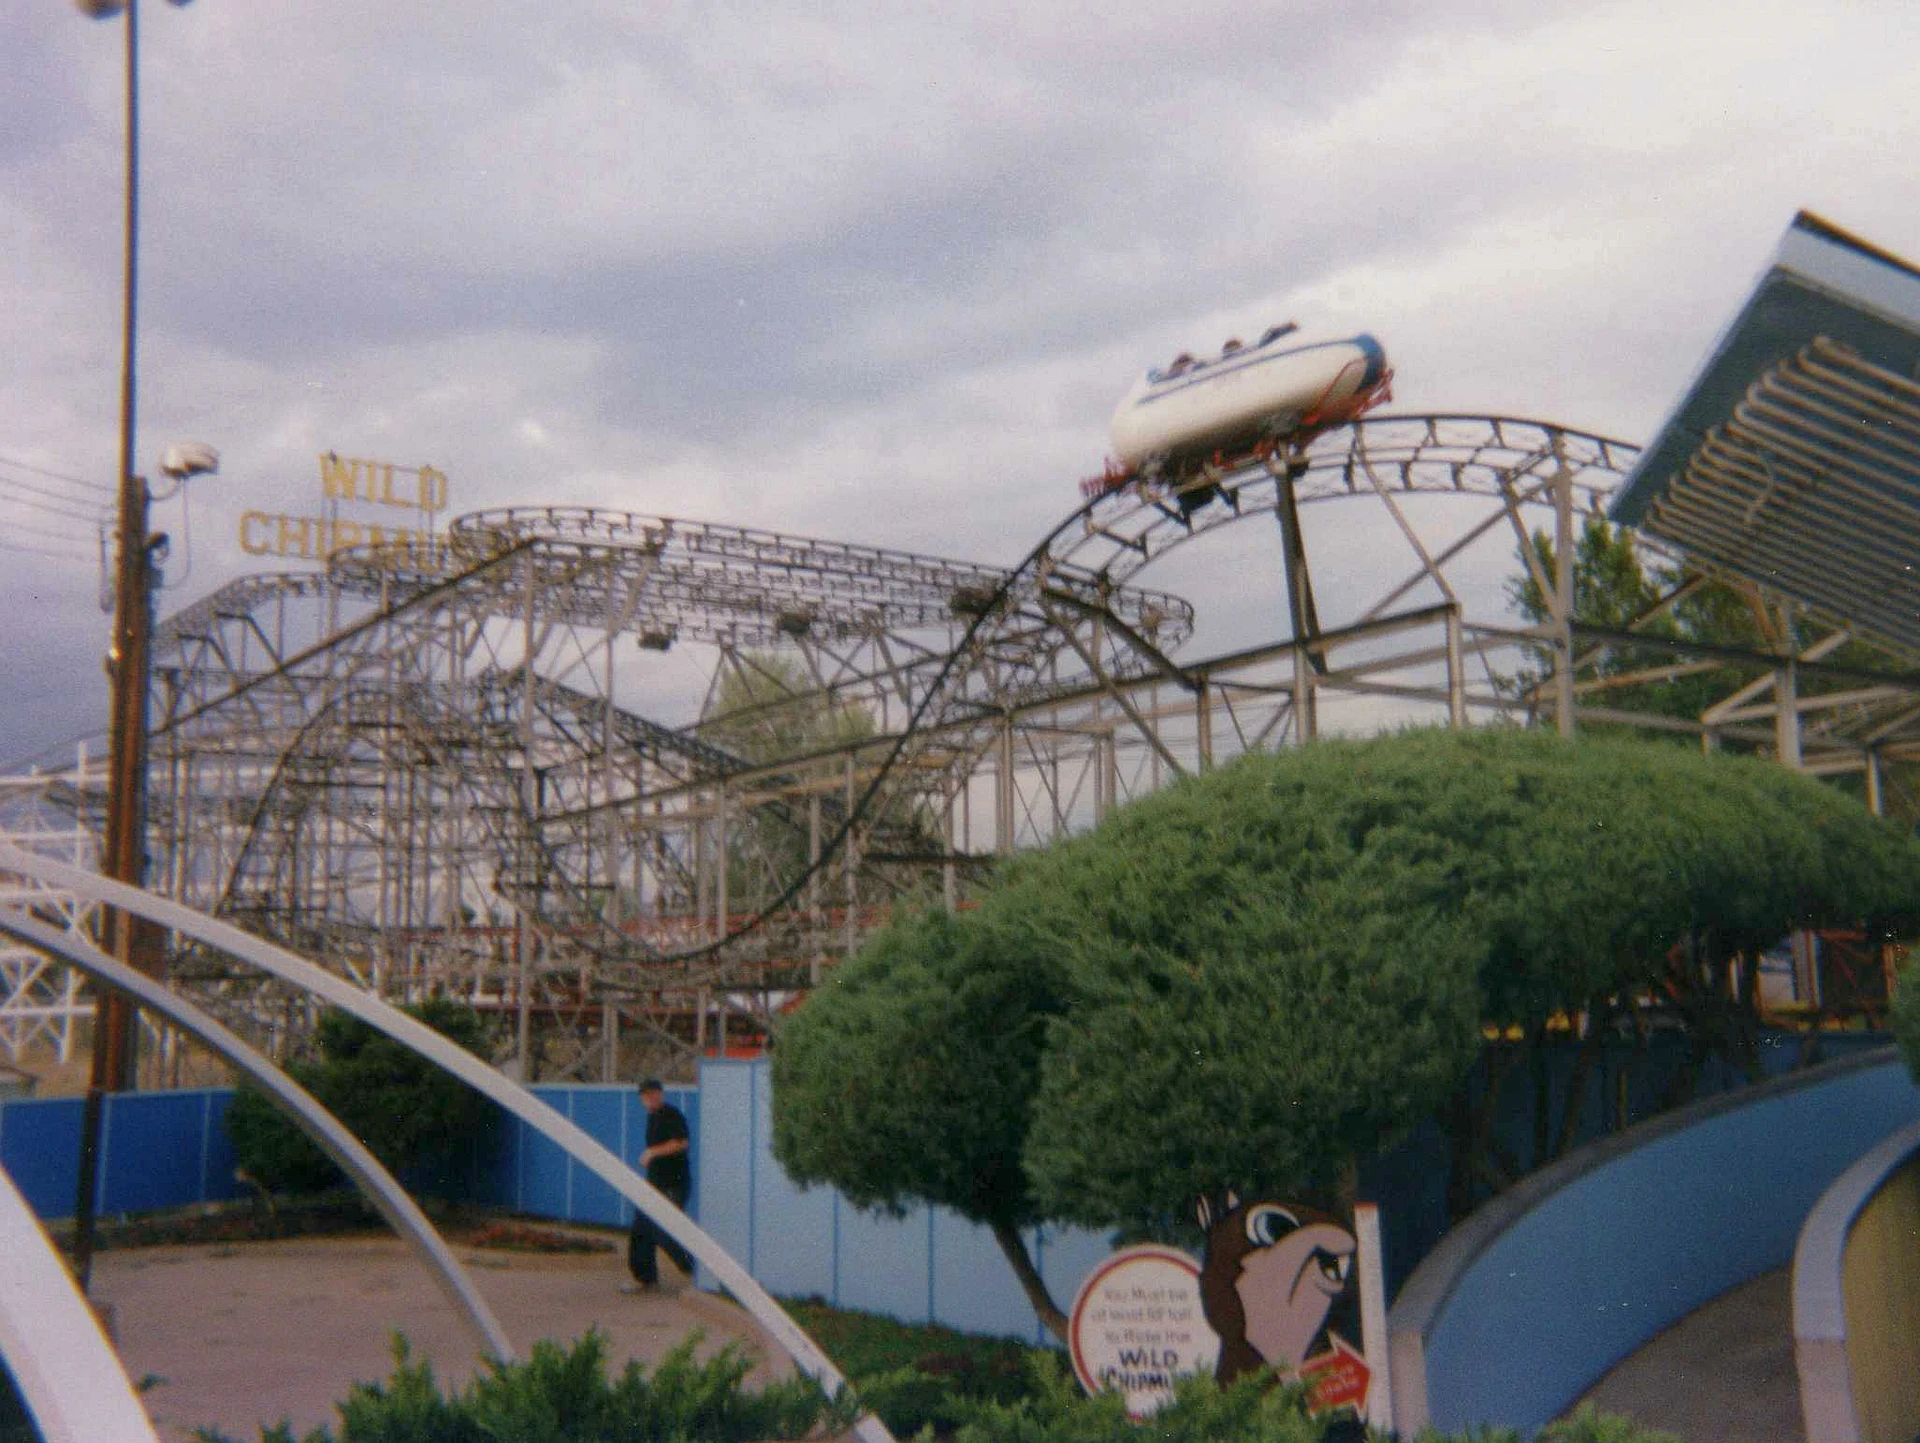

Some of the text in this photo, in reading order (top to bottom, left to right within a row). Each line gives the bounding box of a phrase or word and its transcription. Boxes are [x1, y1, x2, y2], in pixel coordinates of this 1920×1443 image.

[318, 453, 447, 511] WILD
[239, 510, 451, 575] CHIPMU
[1118, 1347, 1178, 1367] WILD
